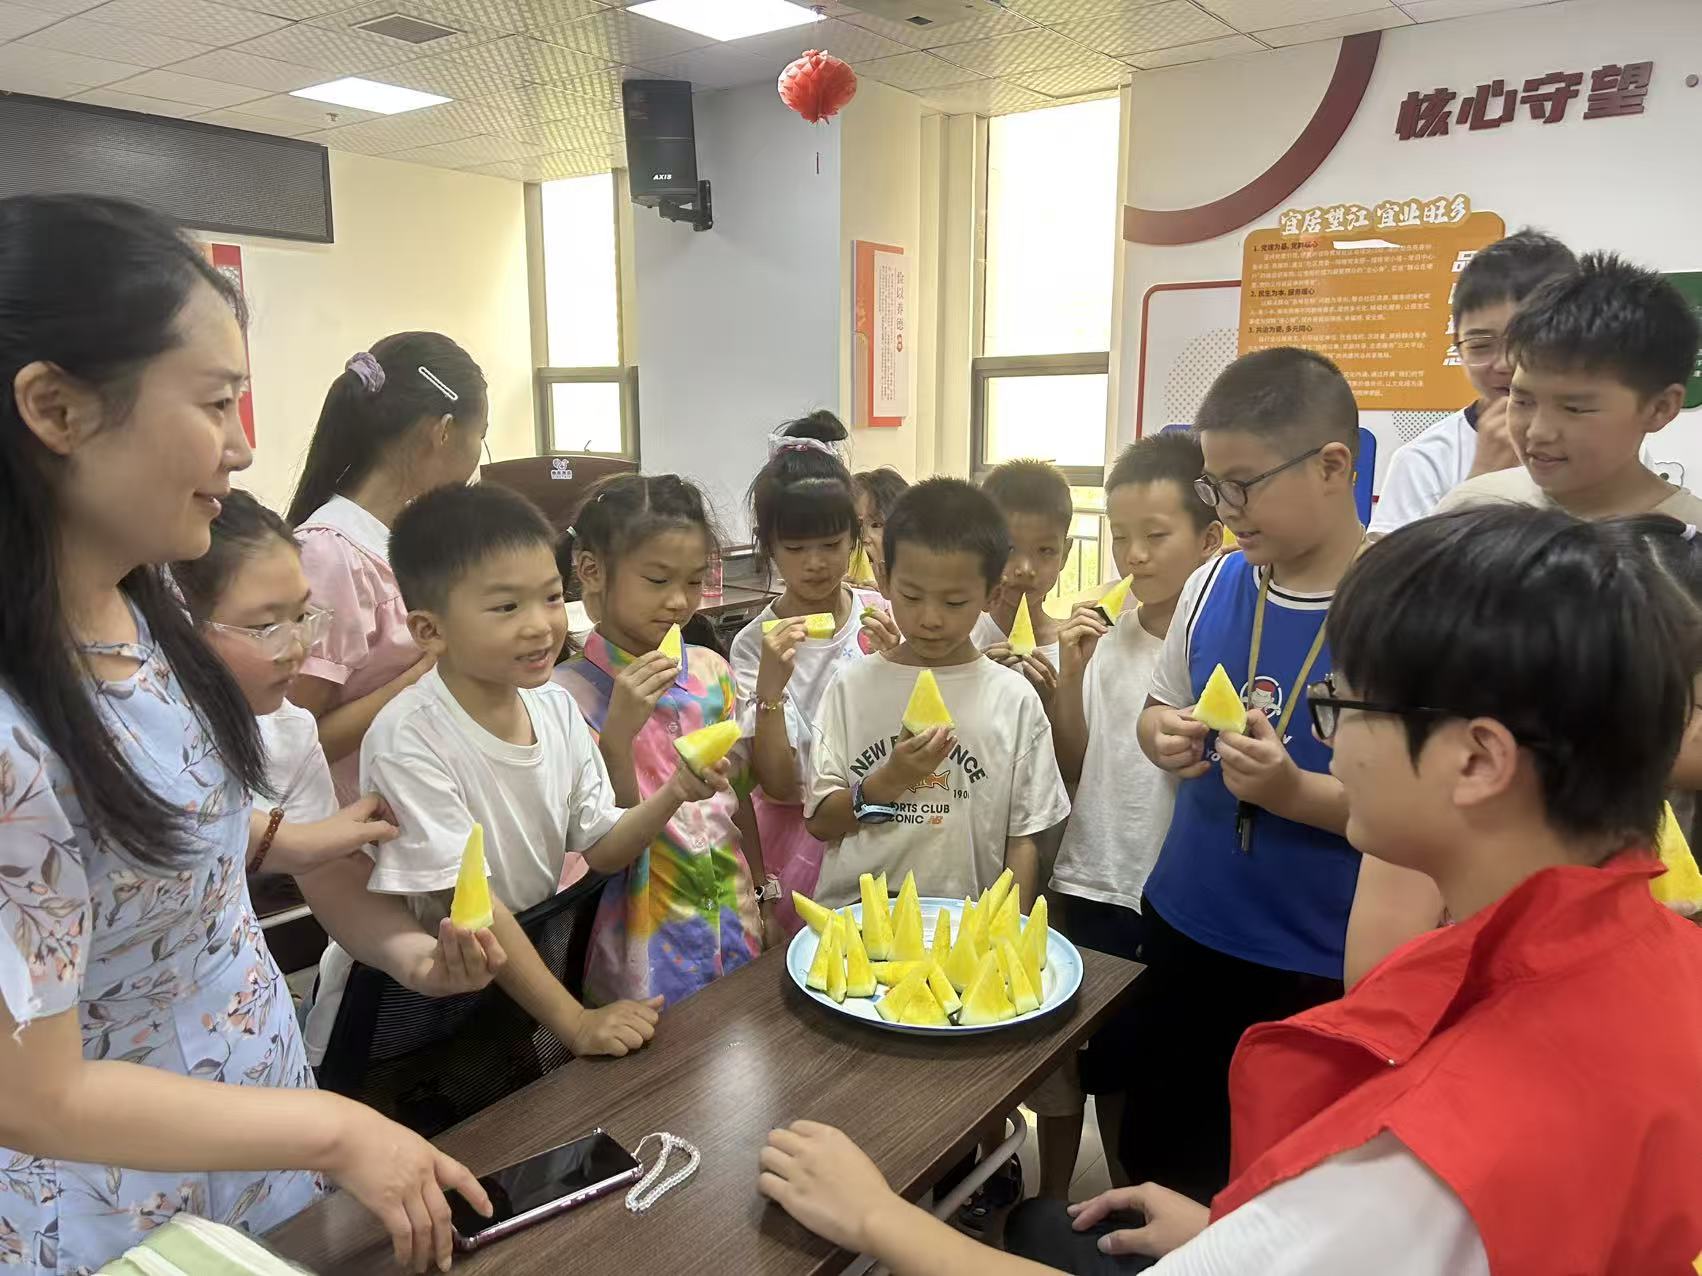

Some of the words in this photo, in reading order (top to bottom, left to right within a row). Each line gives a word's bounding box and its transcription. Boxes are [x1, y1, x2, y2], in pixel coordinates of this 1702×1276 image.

[1395, 61, 1654, 141] 核心守望
[1280, 206, 1370, 236] 宜居望江
[850, 739, 887, 778] NEW
[953, 789, 969, 799] 190
[889, 813, 924, 824] ONIC
[921, 804, 950, 814] CLUB
